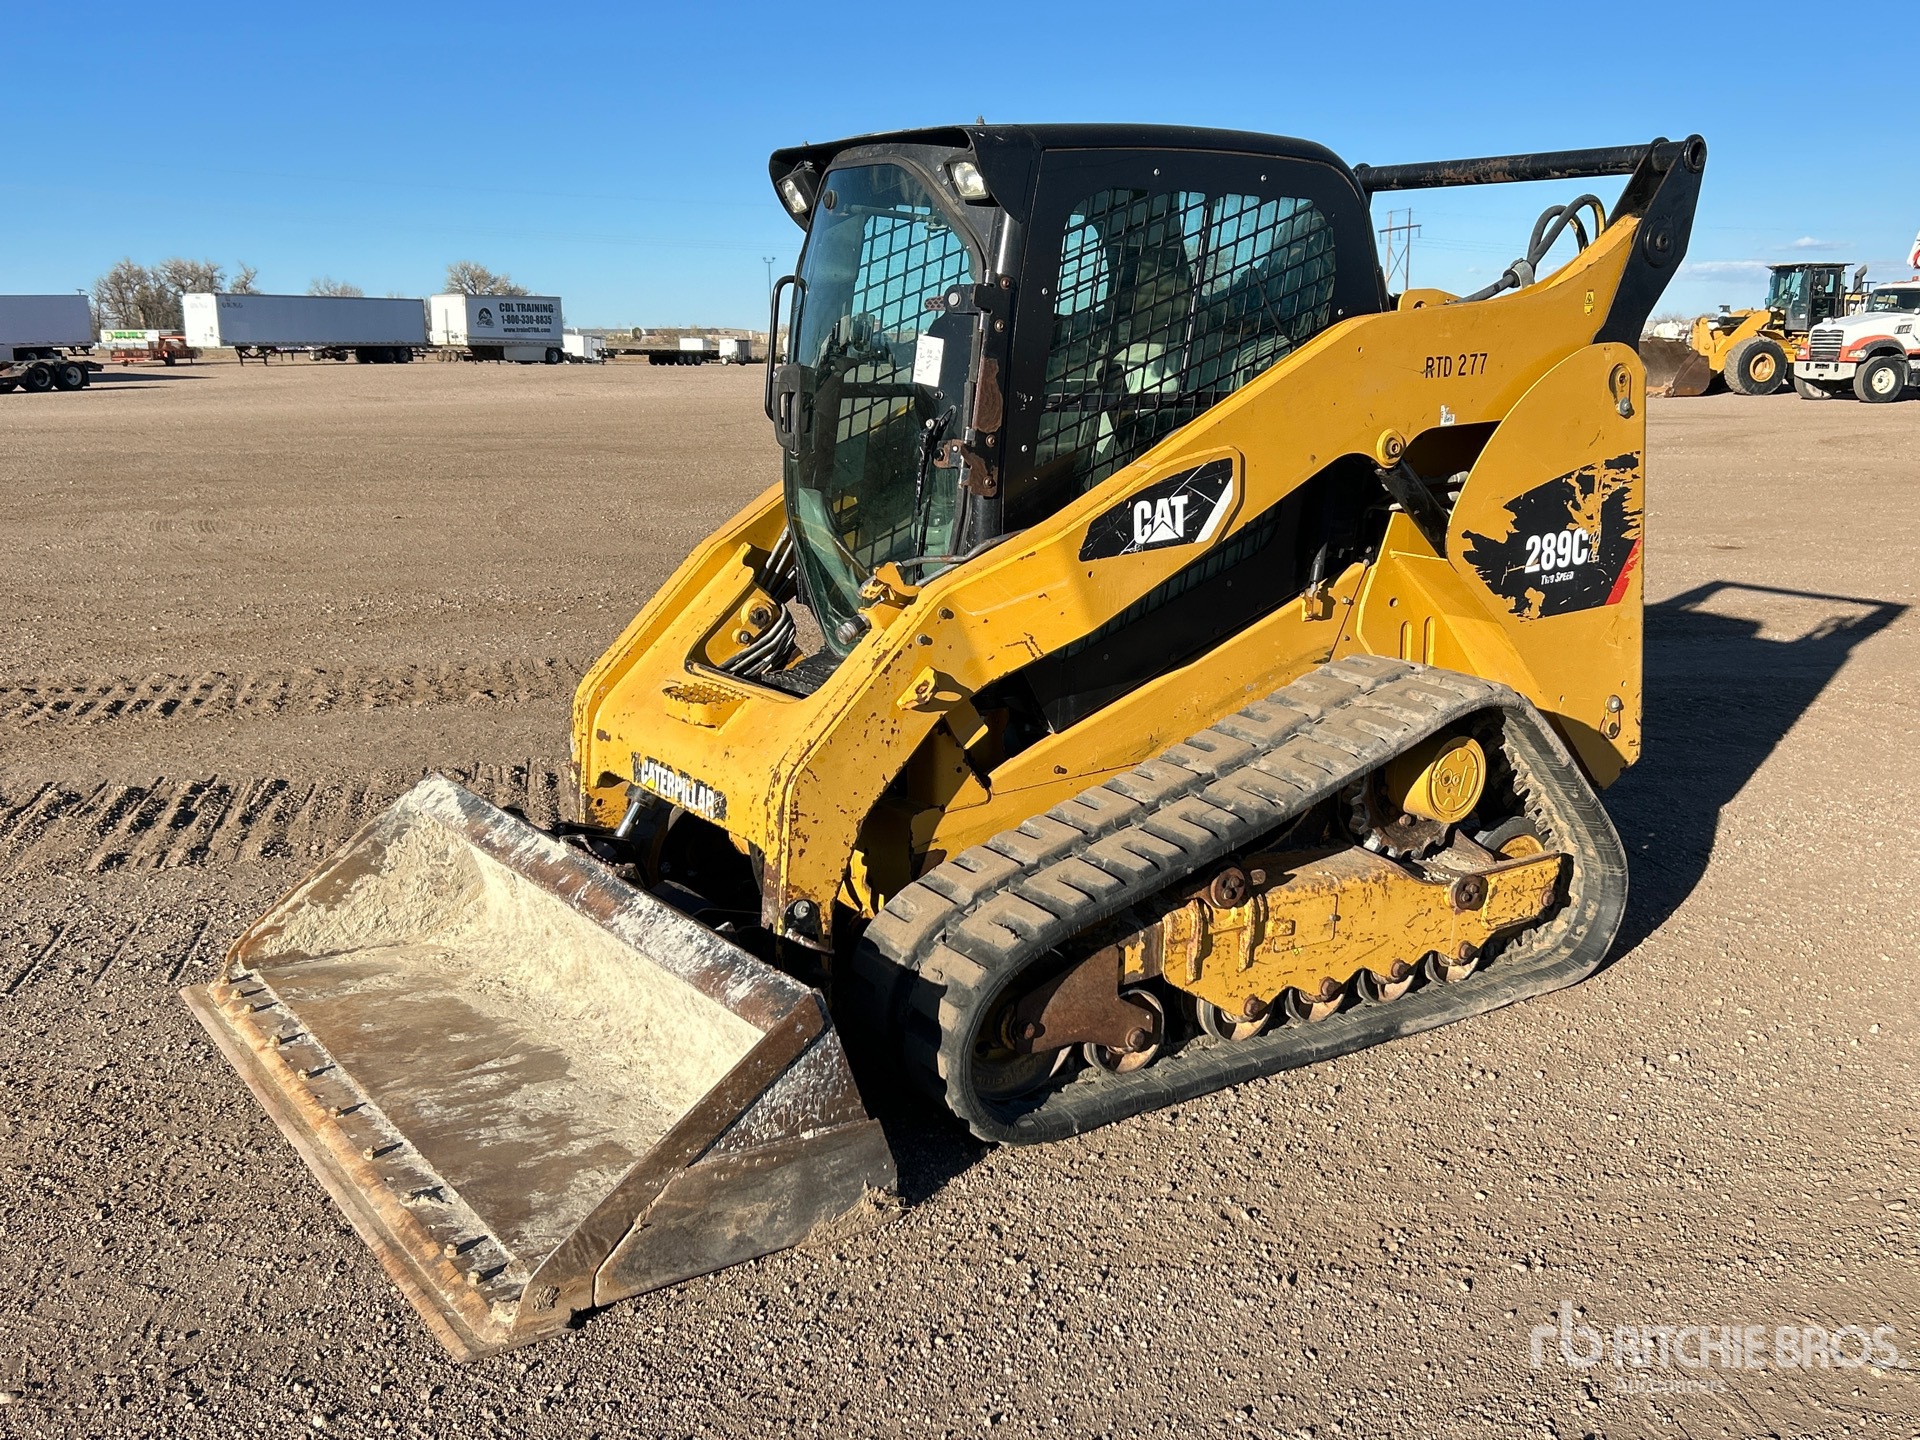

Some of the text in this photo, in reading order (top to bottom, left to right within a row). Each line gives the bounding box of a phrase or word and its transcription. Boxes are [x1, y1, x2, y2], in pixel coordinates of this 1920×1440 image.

[499, 302, 554, 313] CDL TRAINING
[501, 314, 553, 325] 1-800-330-8835
[1425, 353, 1488, 378] RTD 277
[1133, 494, 1188, 545] CAT
[641, 757, 716, 819] CATERPILLAR
